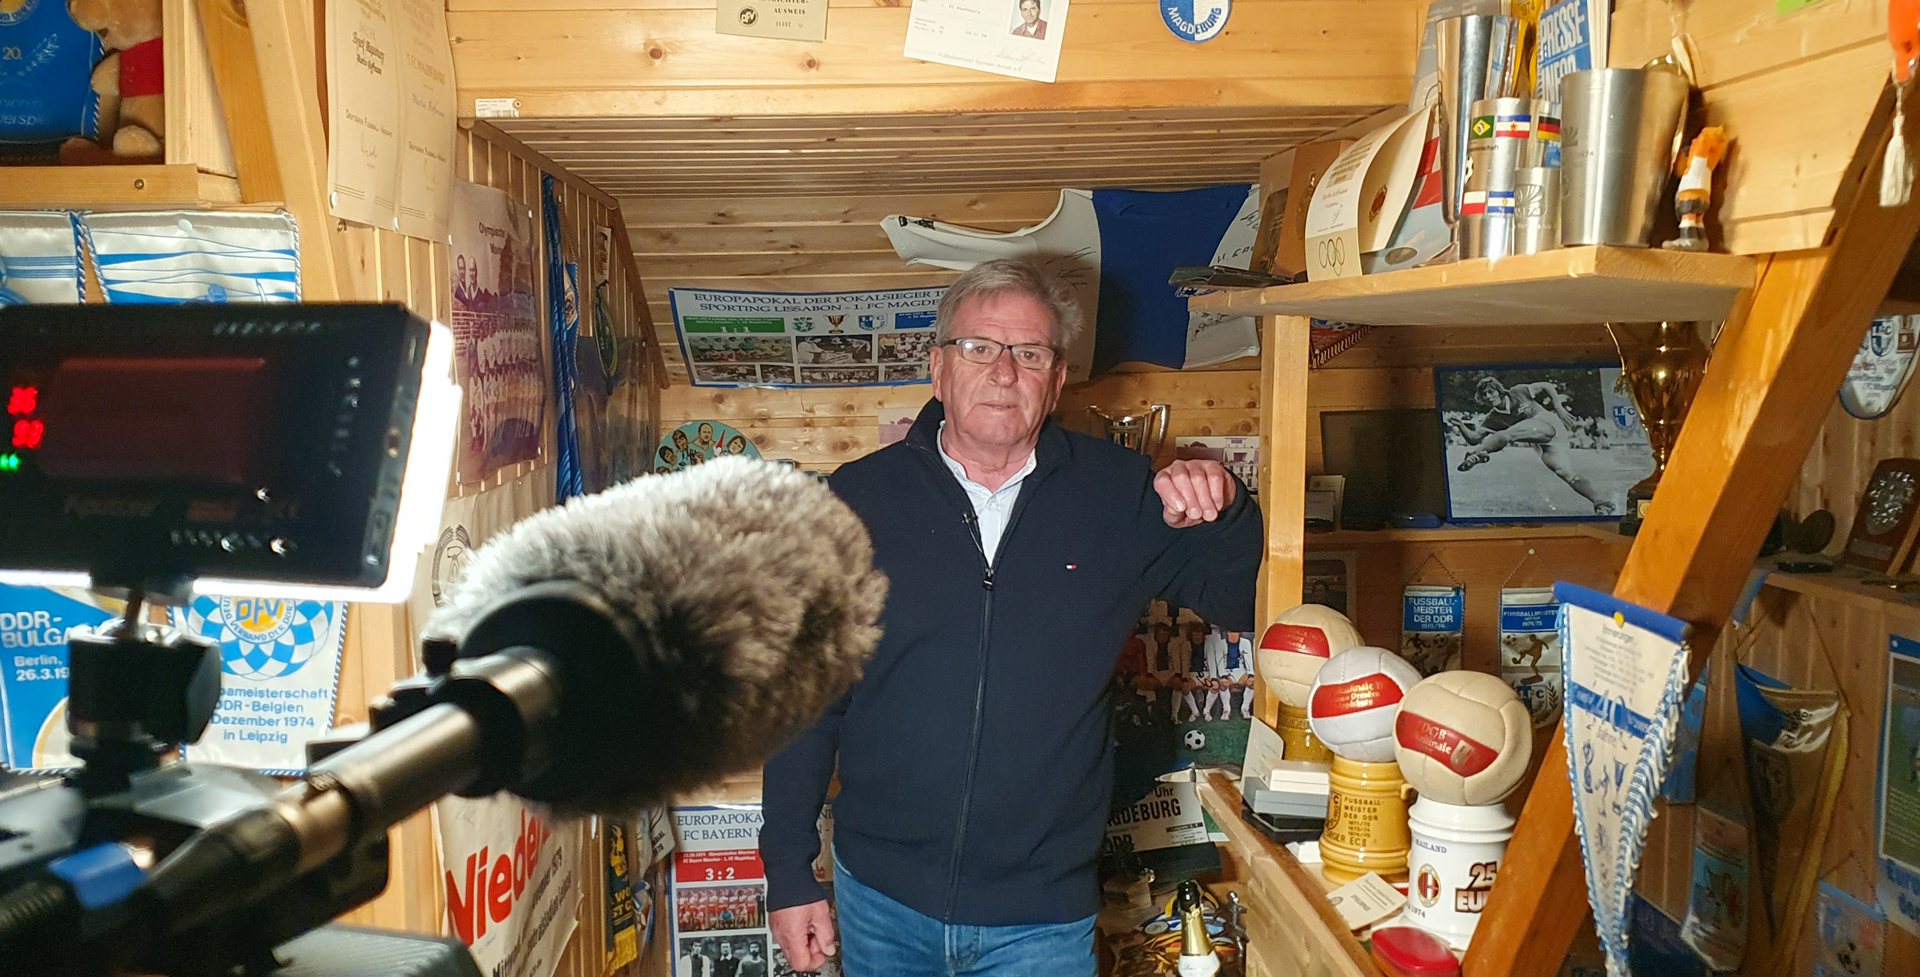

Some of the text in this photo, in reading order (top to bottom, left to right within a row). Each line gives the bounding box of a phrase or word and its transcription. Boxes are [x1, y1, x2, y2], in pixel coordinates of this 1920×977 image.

[773, 7, 806, 15] AUSWEIS
[1167, 7, 1222, 34] MAGDEBURG
[1540, 0, 1585, 61] PRESSE
[693, 293, 801, 305] EUROPAPOKAL
[804, 296, 833, 305] DER
[835, 291, 931, 304] POKALSIEGER
[700, 303, 773, 312] SPORTING
[774, 304, 842, 313] LISSABON
[1409, 597, 1458, 606] FUSSBALL-
[1413, 606, 1453, 615] MEISTER
[1413, 614, 1454, 624] DER DDR
[14, 655, 63, 668] Berlin,
[1350, 691, 1380, 700] Dresden
[210, 714, 315, 728] Dezember 1974
[223, 729, 288, 744] in Leipzig
[1154, 787, 1174, 799] Uhr
[1344, 796, 1385, 806] FUSSBALL-
[1344, 805, 1378, 814] MEISTER
[677, 812, 764, 826] EUROPAPOKA
[683, 830, 700, 841] FC
[702, 828, 753, 840] BAYERN
[1415, 838, 1448, 854] MAILAND
[705, 868, 714, 881] 3
[725, 867, 735, 880] 2
[1469, 861, 1498, 890] 25
[1410, 905, 1426, 919] 1974
